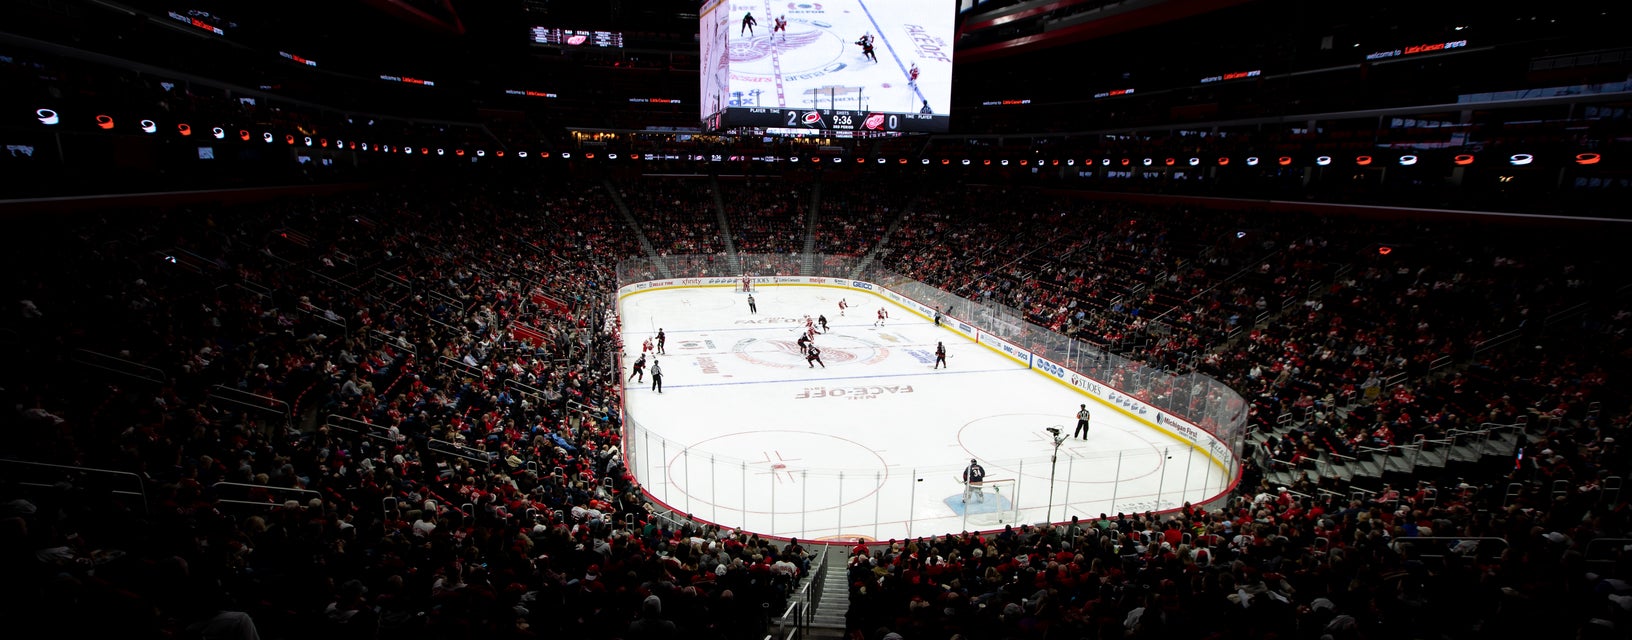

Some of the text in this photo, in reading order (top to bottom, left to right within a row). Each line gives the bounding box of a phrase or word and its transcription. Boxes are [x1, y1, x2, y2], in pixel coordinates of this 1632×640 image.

[1366, 50, 1394, 60] welcome
[1444, 40, 1467, 49] arena
[787, 111, 797, 126] 2
[833, 115, 852, 125] 9:36
[889, 115, 898, 129] 0
[853, 281, 873, 291] GEICO
[795, 385, 914, 399] FACE-OFF
[1164, 417, 1198, 439] Michigan First
